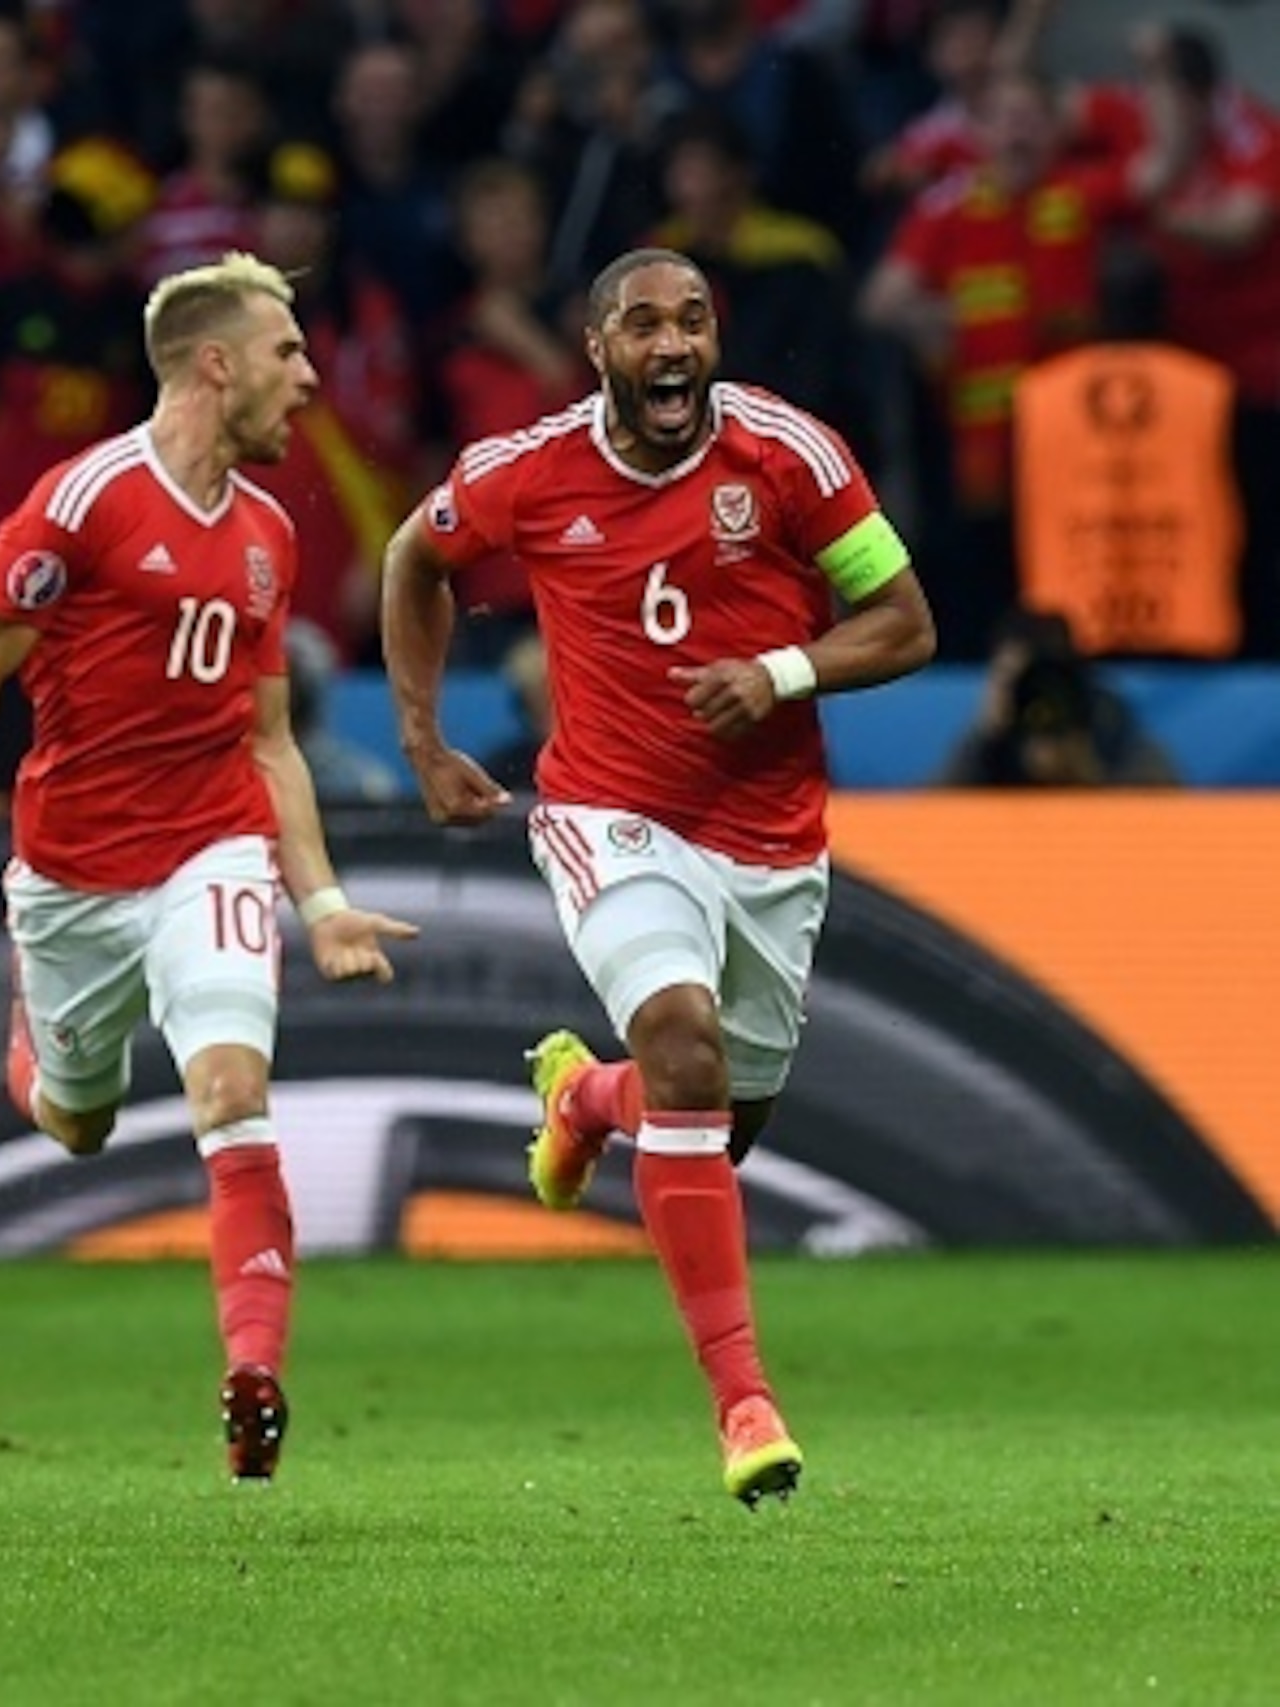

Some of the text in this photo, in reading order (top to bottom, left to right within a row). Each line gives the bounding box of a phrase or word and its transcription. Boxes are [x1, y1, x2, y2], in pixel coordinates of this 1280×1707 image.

[165, 597, 237, 684] 10
[641, 560, 691, 646] 6
[206, 883, 267, 955] 10
